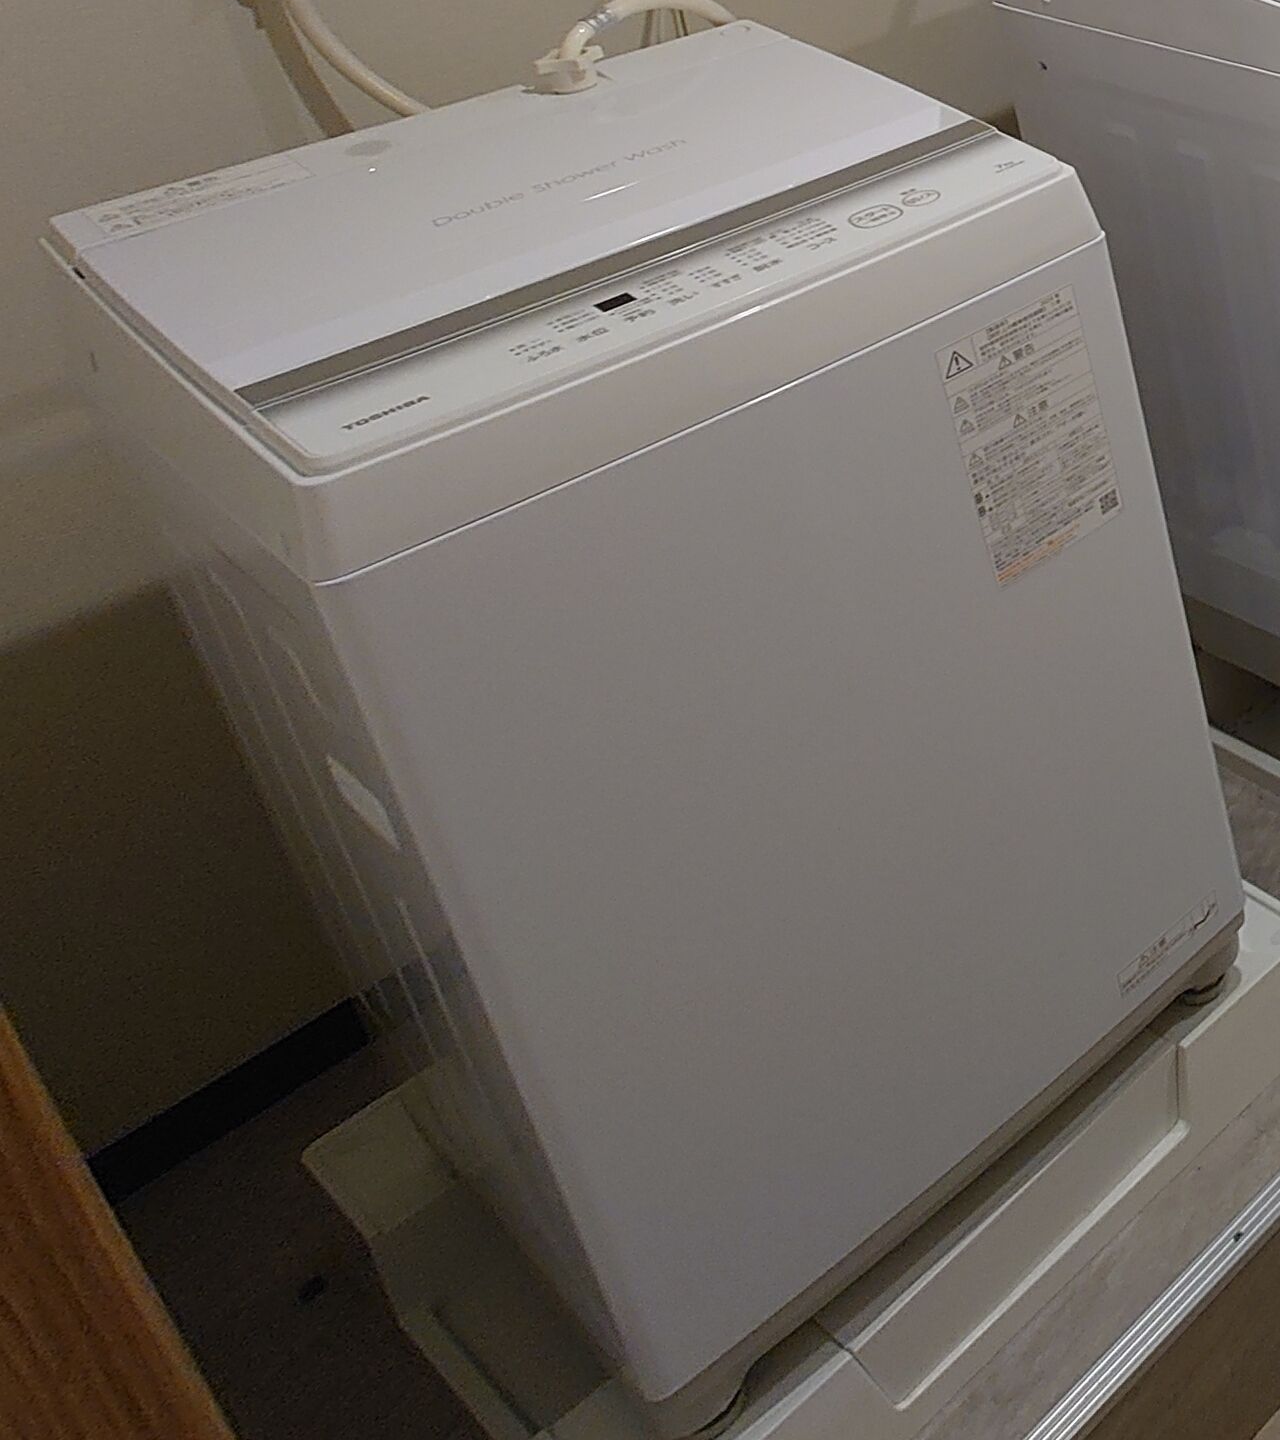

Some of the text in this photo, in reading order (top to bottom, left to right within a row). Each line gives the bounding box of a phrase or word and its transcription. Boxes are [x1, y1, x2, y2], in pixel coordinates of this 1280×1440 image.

[431, 137, 688, 228] Double Shower Wash
[341, 396, 430, 430] TOSHIBA
